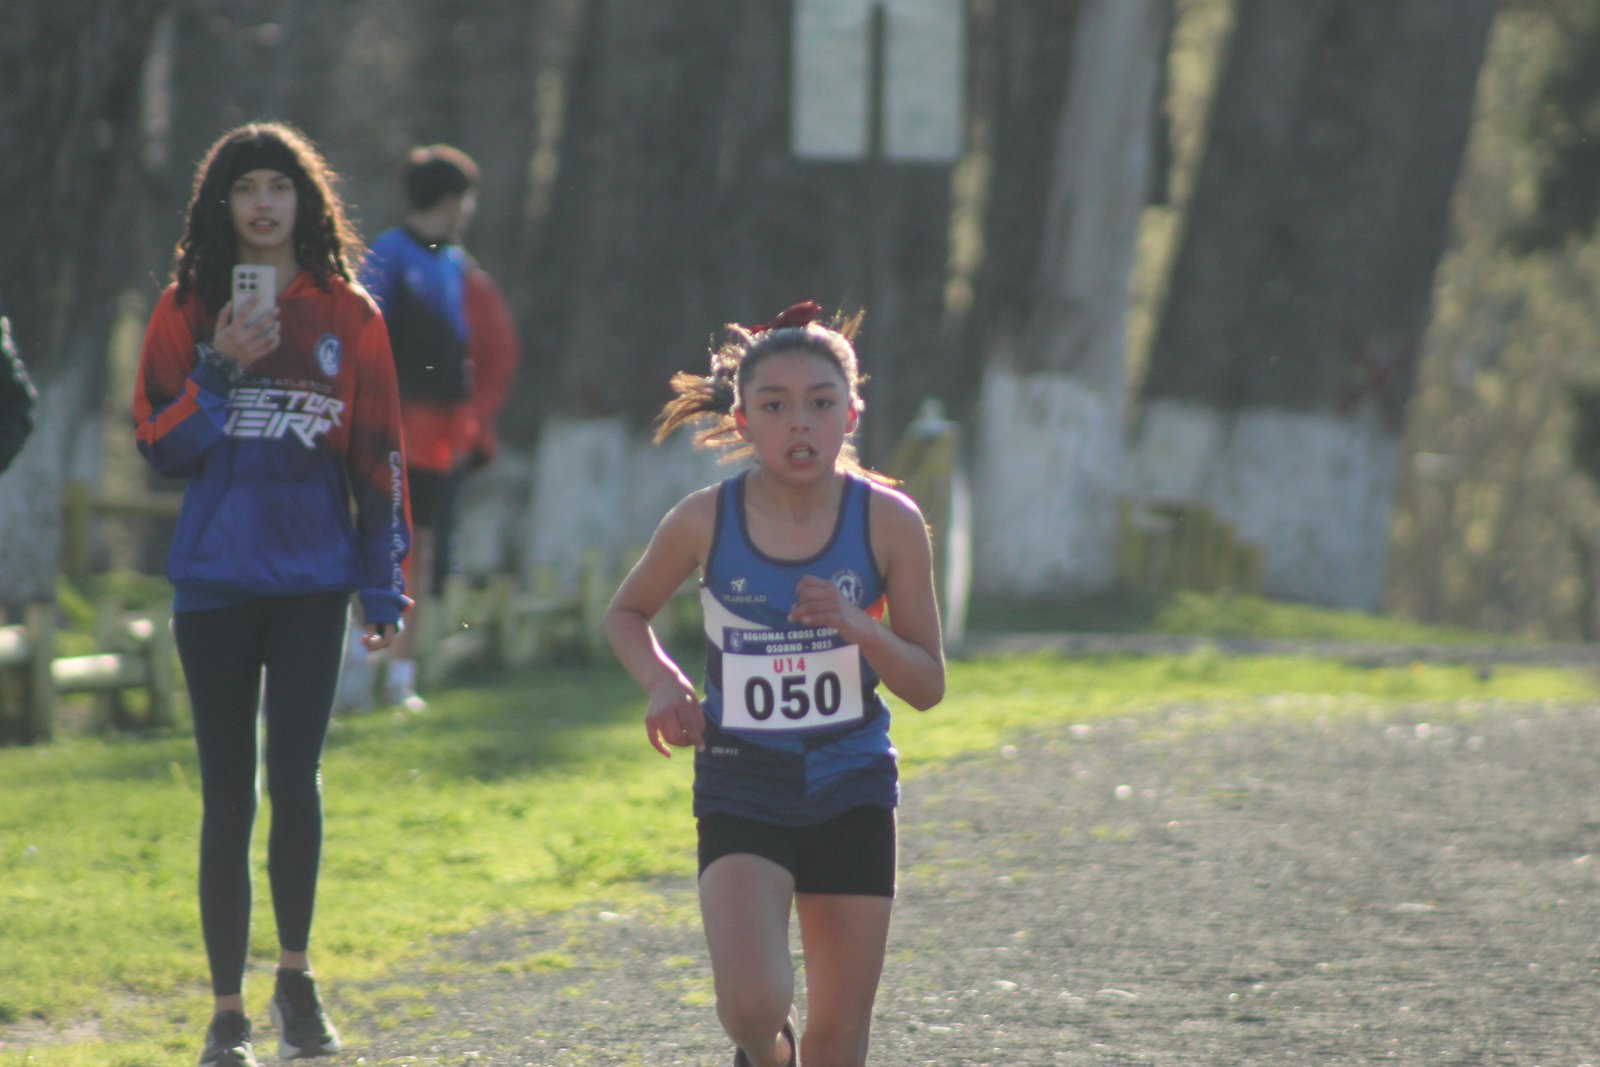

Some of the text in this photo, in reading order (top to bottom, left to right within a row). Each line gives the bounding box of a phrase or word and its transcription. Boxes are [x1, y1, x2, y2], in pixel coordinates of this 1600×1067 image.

[226, 387, 345, 427] ECTOR
[389, 450, 402, 528] CAMILA
[743, 631, 785, 641] REGIONAL
[787, 630, 814, 640] CROSS
[766, 643, 802, 653] OSORNO
[811, 640, 832, 650] 2025
[773, 656, 807, 674] U14
[744, 670, 842, 721] 050
